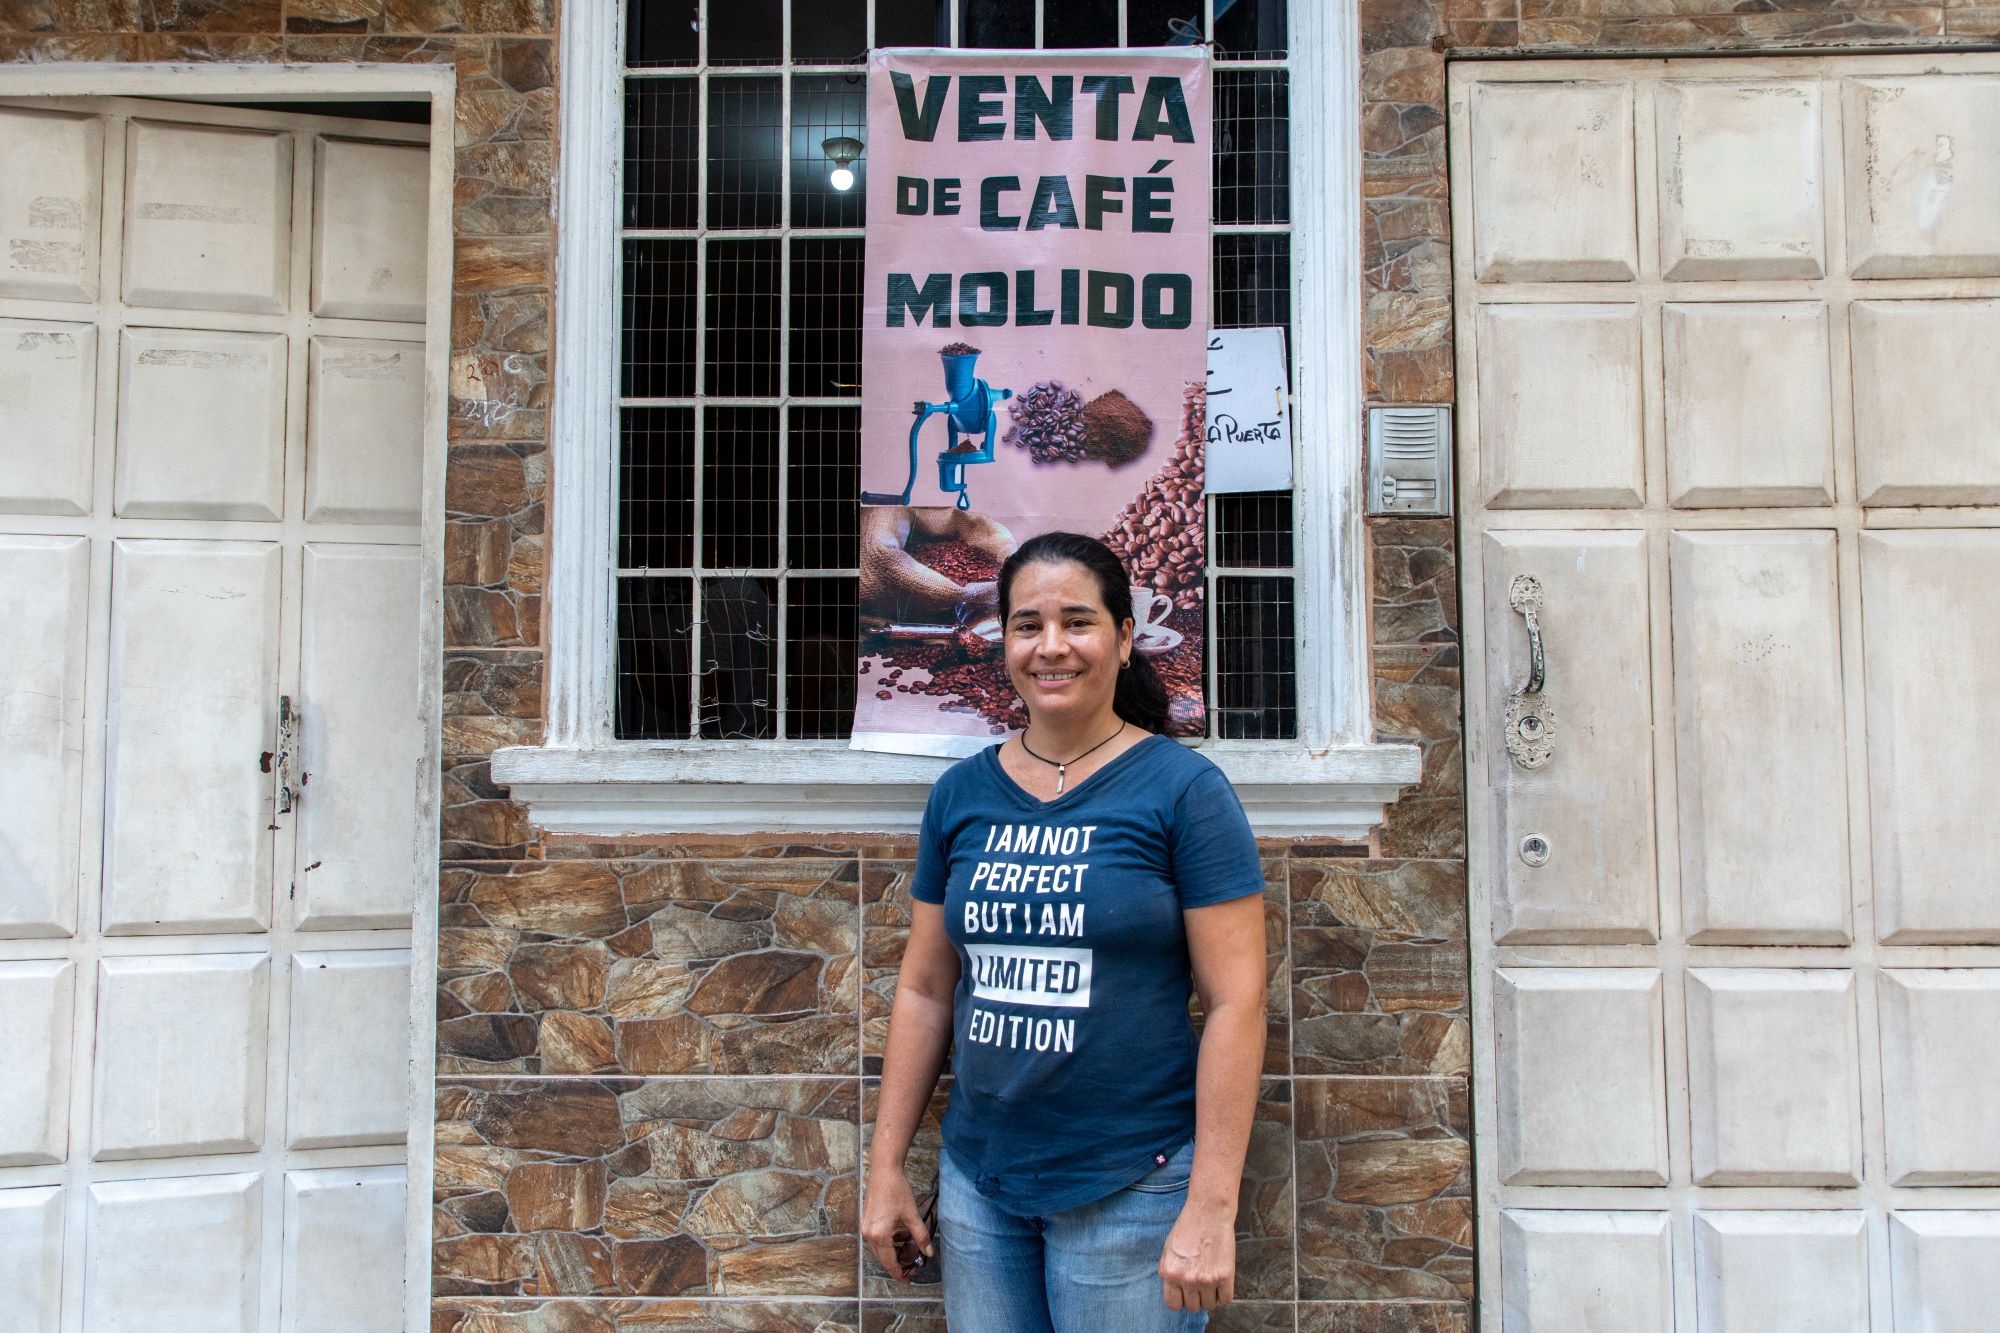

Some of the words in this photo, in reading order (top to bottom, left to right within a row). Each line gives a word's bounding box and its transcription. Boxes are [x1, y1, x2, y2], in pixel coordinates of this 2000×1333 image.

[890, 71, 1195, 143] VENTA
[896, 176, 962, 215] DE
[979, 160, 1175, 233] CAFÉ
[886, 269, 1192, 329] MOLIDO
[984, 825, 996, 853] I
[994, 825, 1040, 853] AM
[1040, 826, 1097, 855] NOT
[970, 862, 1089, 893] PERFECT
[964, 902, 1017, 934] BUT
[1024, 903, 1032, 935] I
[1038, 904, 1085, 937] AM
[977, 955, 1081, 994] LIMITED
[969, 1009, 1076, 1053] EDITION
